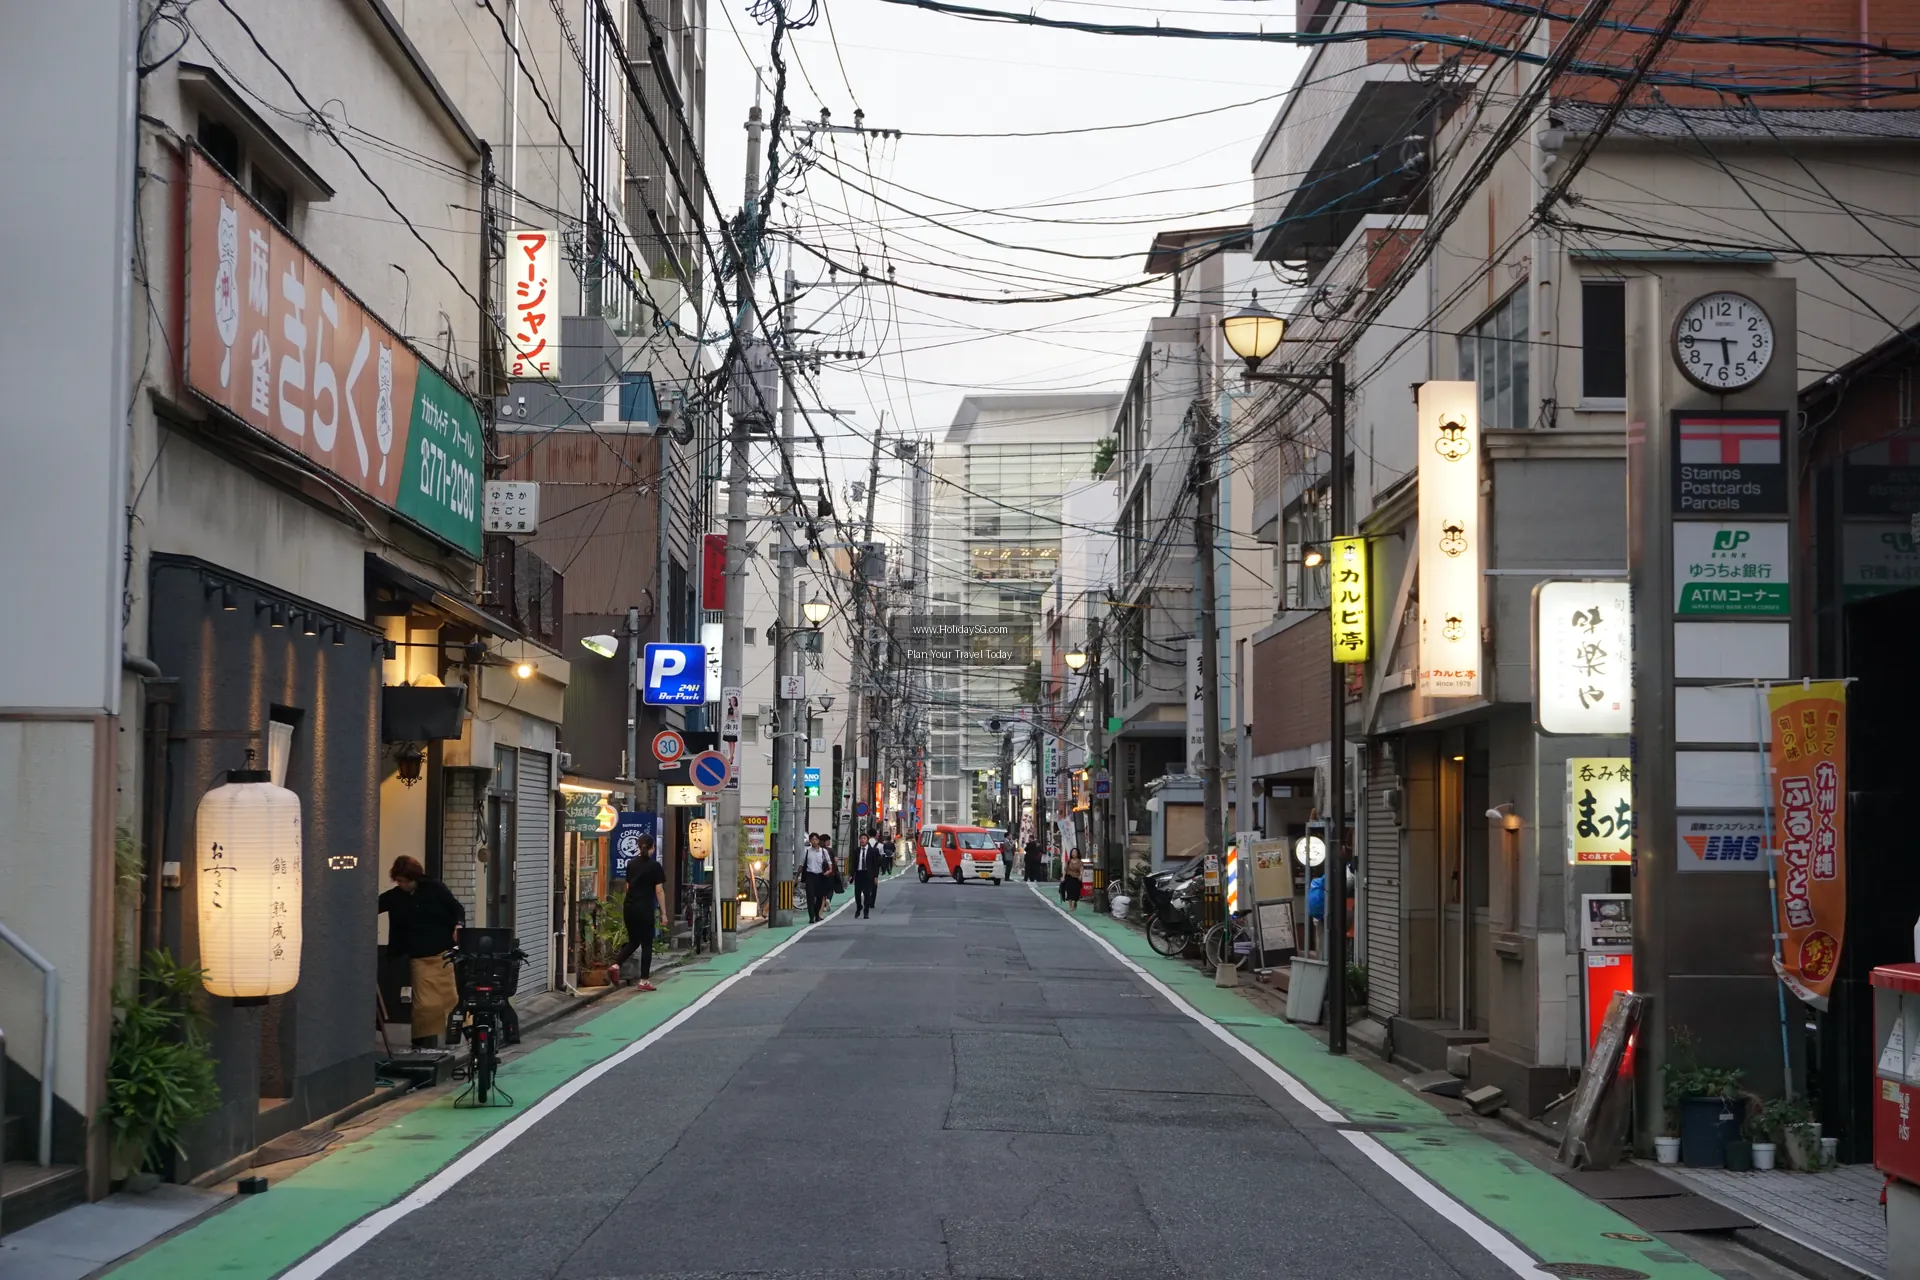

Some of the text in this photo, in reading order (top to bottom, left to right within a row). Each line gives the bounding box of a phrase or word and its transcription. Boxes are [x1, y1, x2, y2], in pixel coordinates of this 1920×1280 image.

[516, 234, 548, 361] マージャン
[1716, 302, 1732, 317] 12
[248, 228, 271, 417] 麻雀
[1688, 318, 1703, 332] 10
[1747, 317, 1758, 331] 2
[1751, 334, 1763, 348] 3
[1689, 350, 1701, 364] 8
[1747, 350, 1758, 364] 4
[278, 260, 370, 478] きらく
[1703, 363, 1714, 377] 7
[1718, 366, 1729, 381] 6
[1735, 362, 1746, 377] 5
[1681, 467, 1741, 481] Stamps
[1681, 481, 1761, 495] Postcards
[491, 491, 527, 501] ゆたか
[491, 506, 527, 515] たごと
[1681, 497, 1740, 510] Parcels
[1713, 530, 1750, 550] JP
[1689, 563, 1772, 579] ゆうちょ銀行
[1691, 588, 1780, 602] ATMコーナー
[1338, 568, 1364, 651] カルビ亭
[649, 649, 687, 689] P
[1433, 669, 1477, 680] カルビ亭
[678, 684, 700, 692] 24H
[1456, 680, 1472, 688] 1978
[1778, 715, 1801, 761] 旬の味
[659, 739, 677, 755] 30
[1045, 776, 1057, 797] 住研
[1704, 835, 1761, 861] EMS
